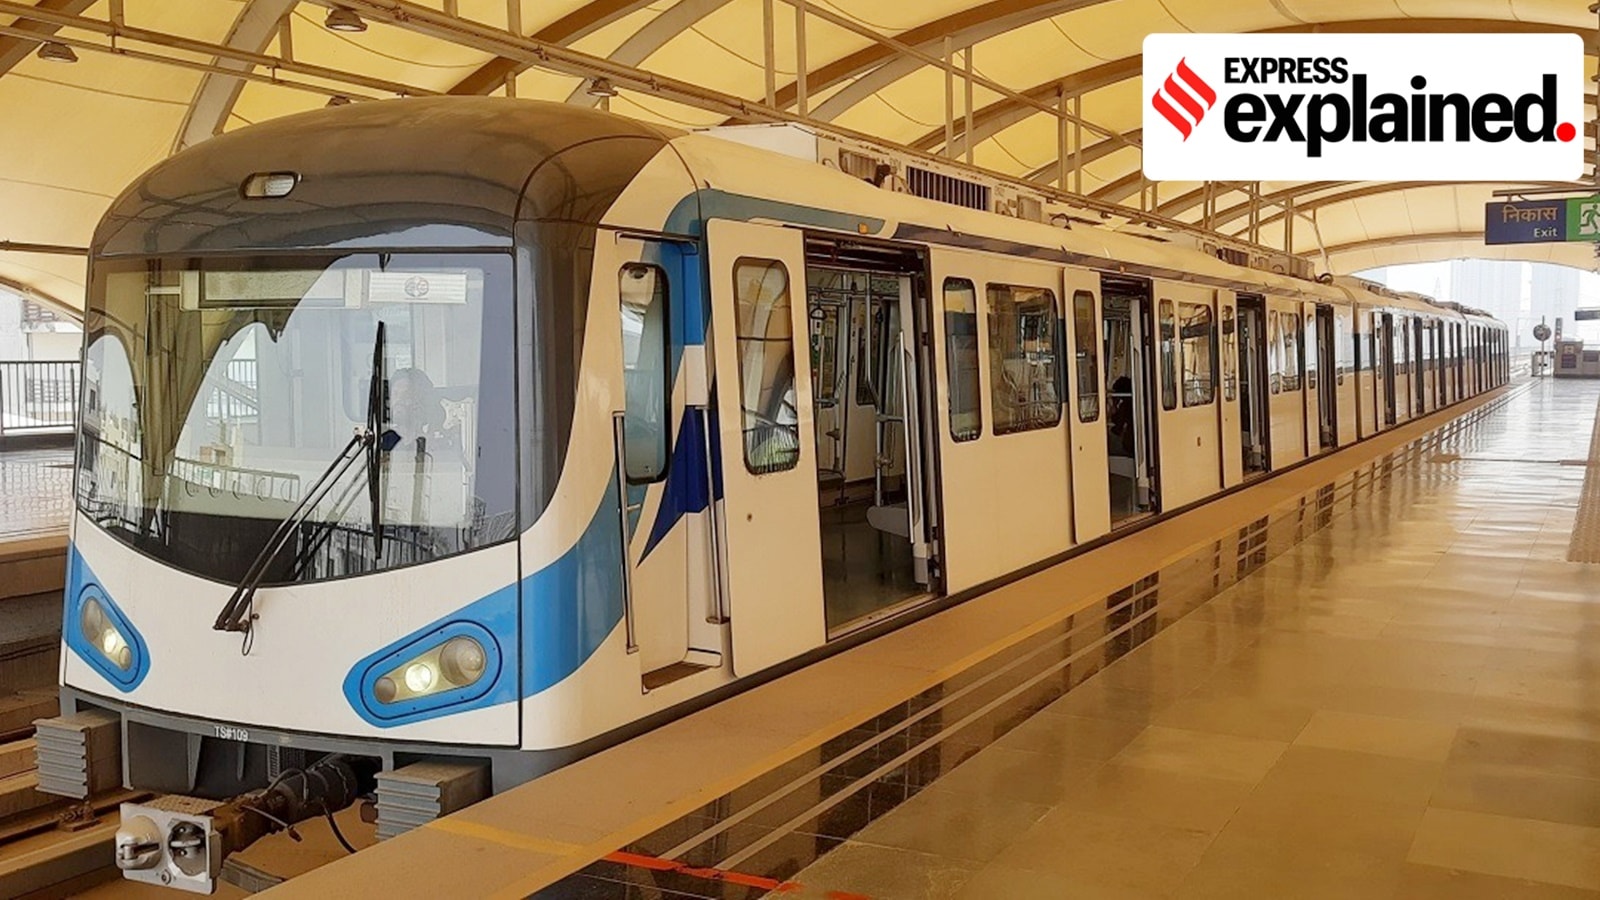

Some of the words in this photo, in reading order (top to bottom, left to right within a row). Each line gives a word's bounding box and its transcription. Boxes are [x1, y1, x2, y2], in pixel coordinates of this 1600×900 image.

[1502, 204, 1558, 223] निकास
[1533, 226, 1558, 238] Exit
[214, 725, 249, 742] TS#109
